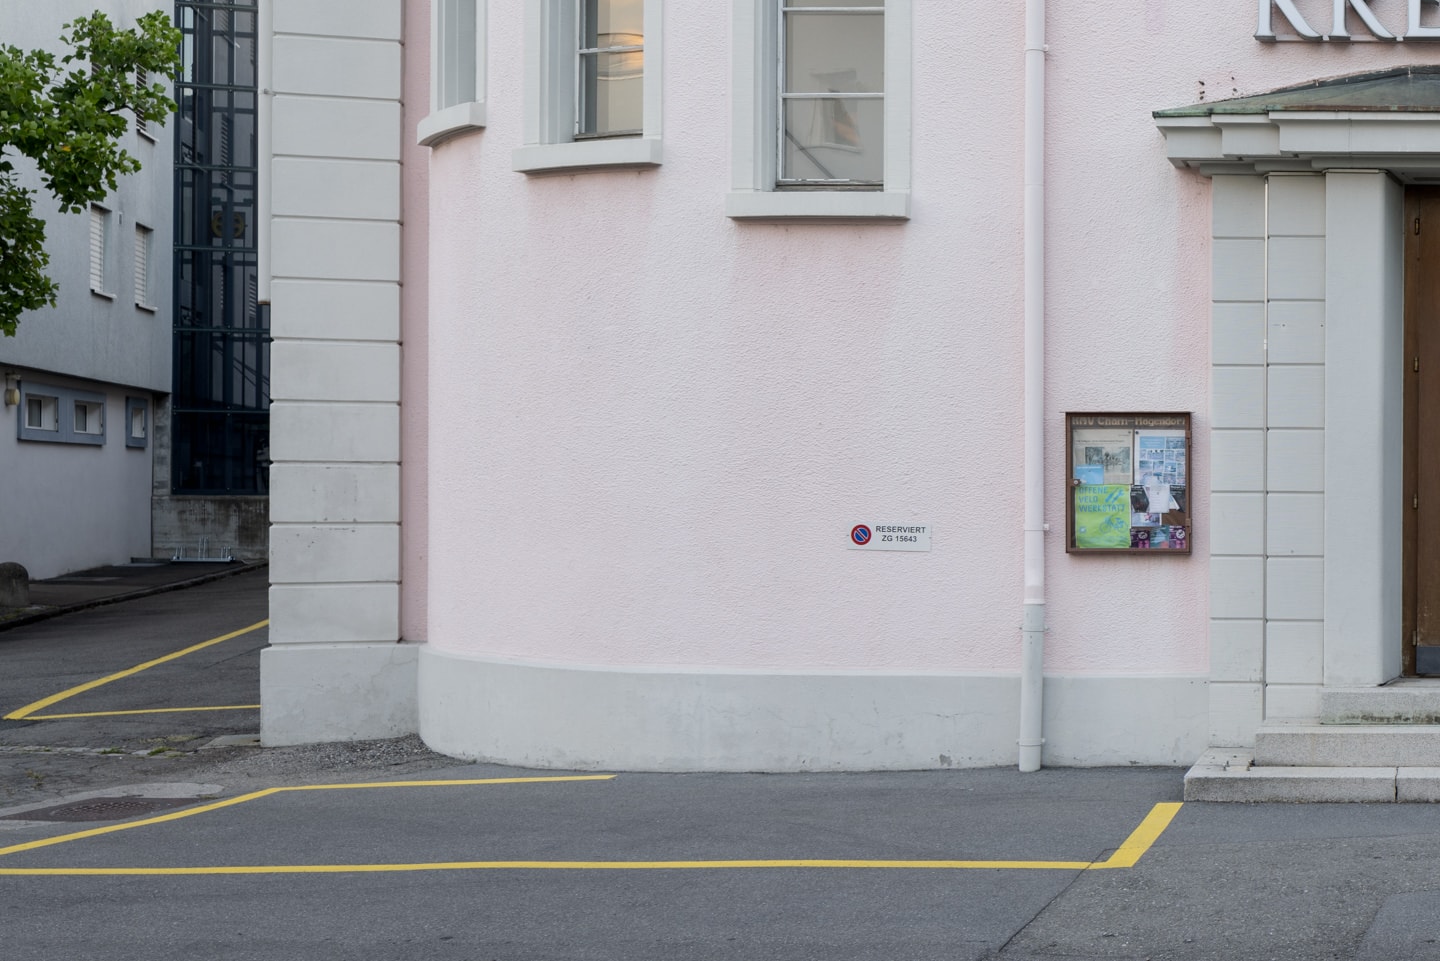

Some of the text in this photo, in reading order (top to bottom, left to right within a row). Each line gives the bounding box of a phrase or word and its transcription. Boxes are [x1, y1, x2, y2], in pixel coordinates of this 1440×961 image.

[1078, 495, 1099, 503] VELO
[1078, 504, 1126, 513] WERKSTATT
[875, 525, 926, 534] RESERVIERT
